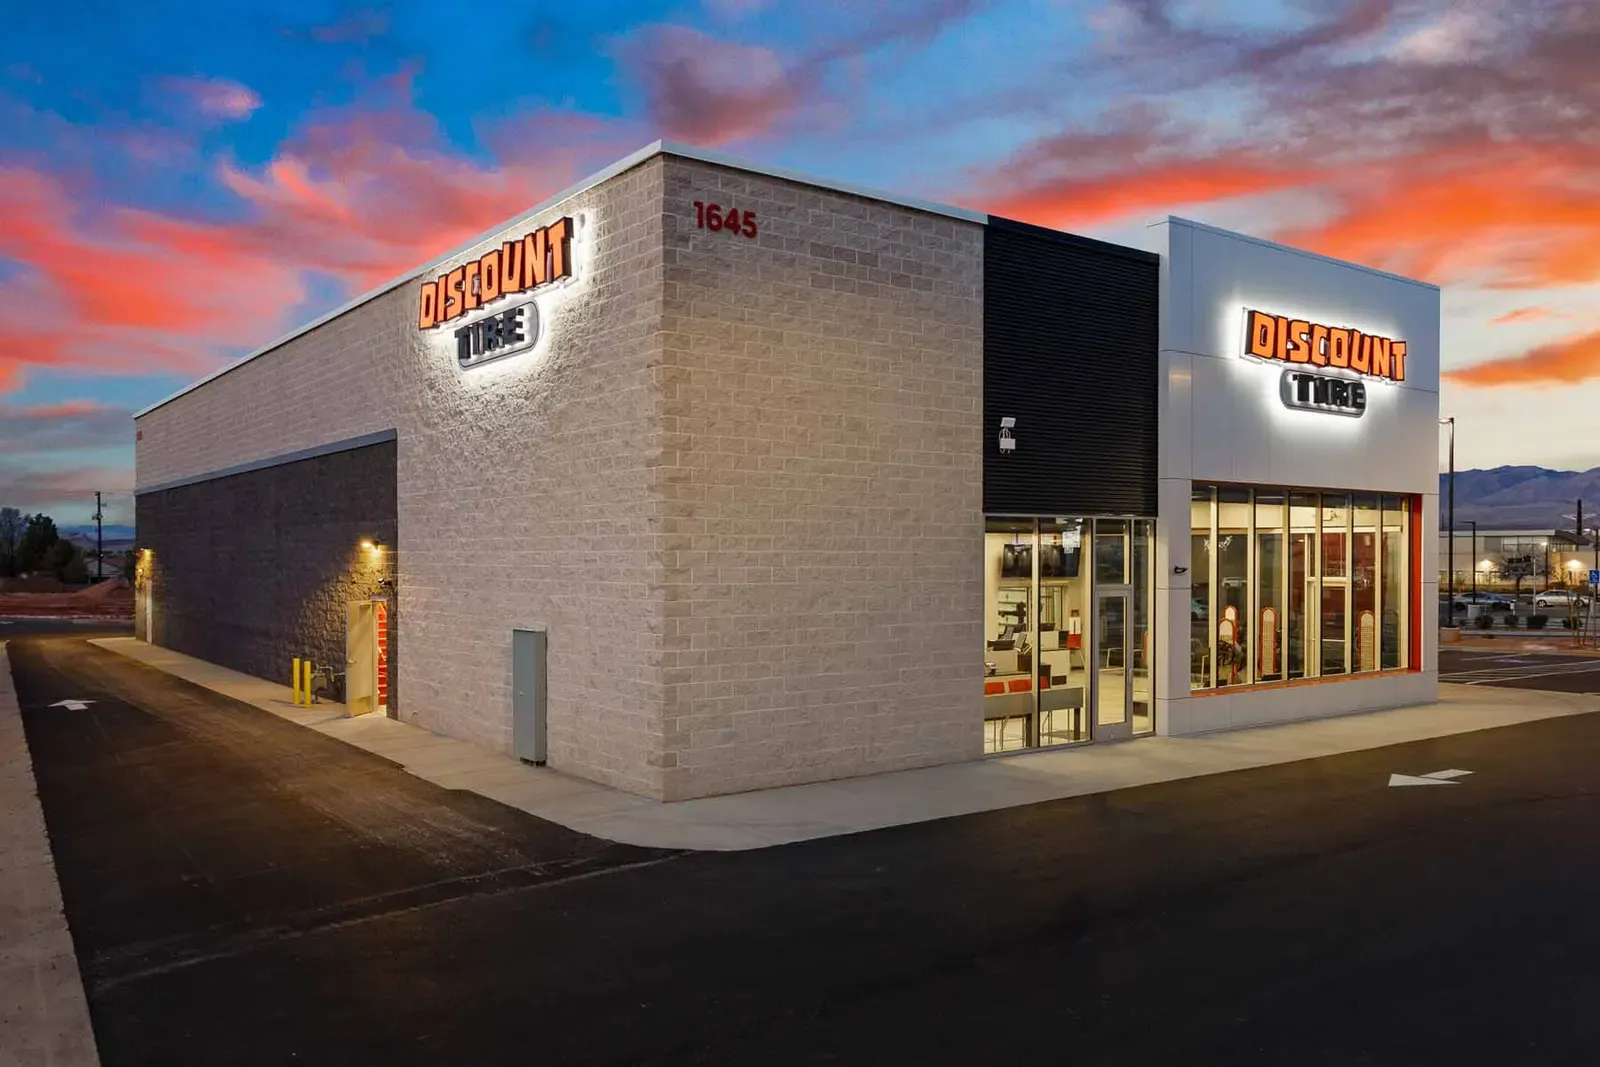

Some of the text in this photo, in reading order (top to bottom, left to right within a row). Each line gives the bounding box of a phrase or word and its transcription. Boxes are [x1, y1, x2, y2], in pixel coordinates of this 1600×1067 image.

[693, 201, 757, 238] 1645
[419, 217, 573, 330] DISCOUNT
[454, 307, 525, 359] TIRE
[1246, 310, 1406, 381] DISCOUNT
[1292, 373, 1366, 409] TIRE
